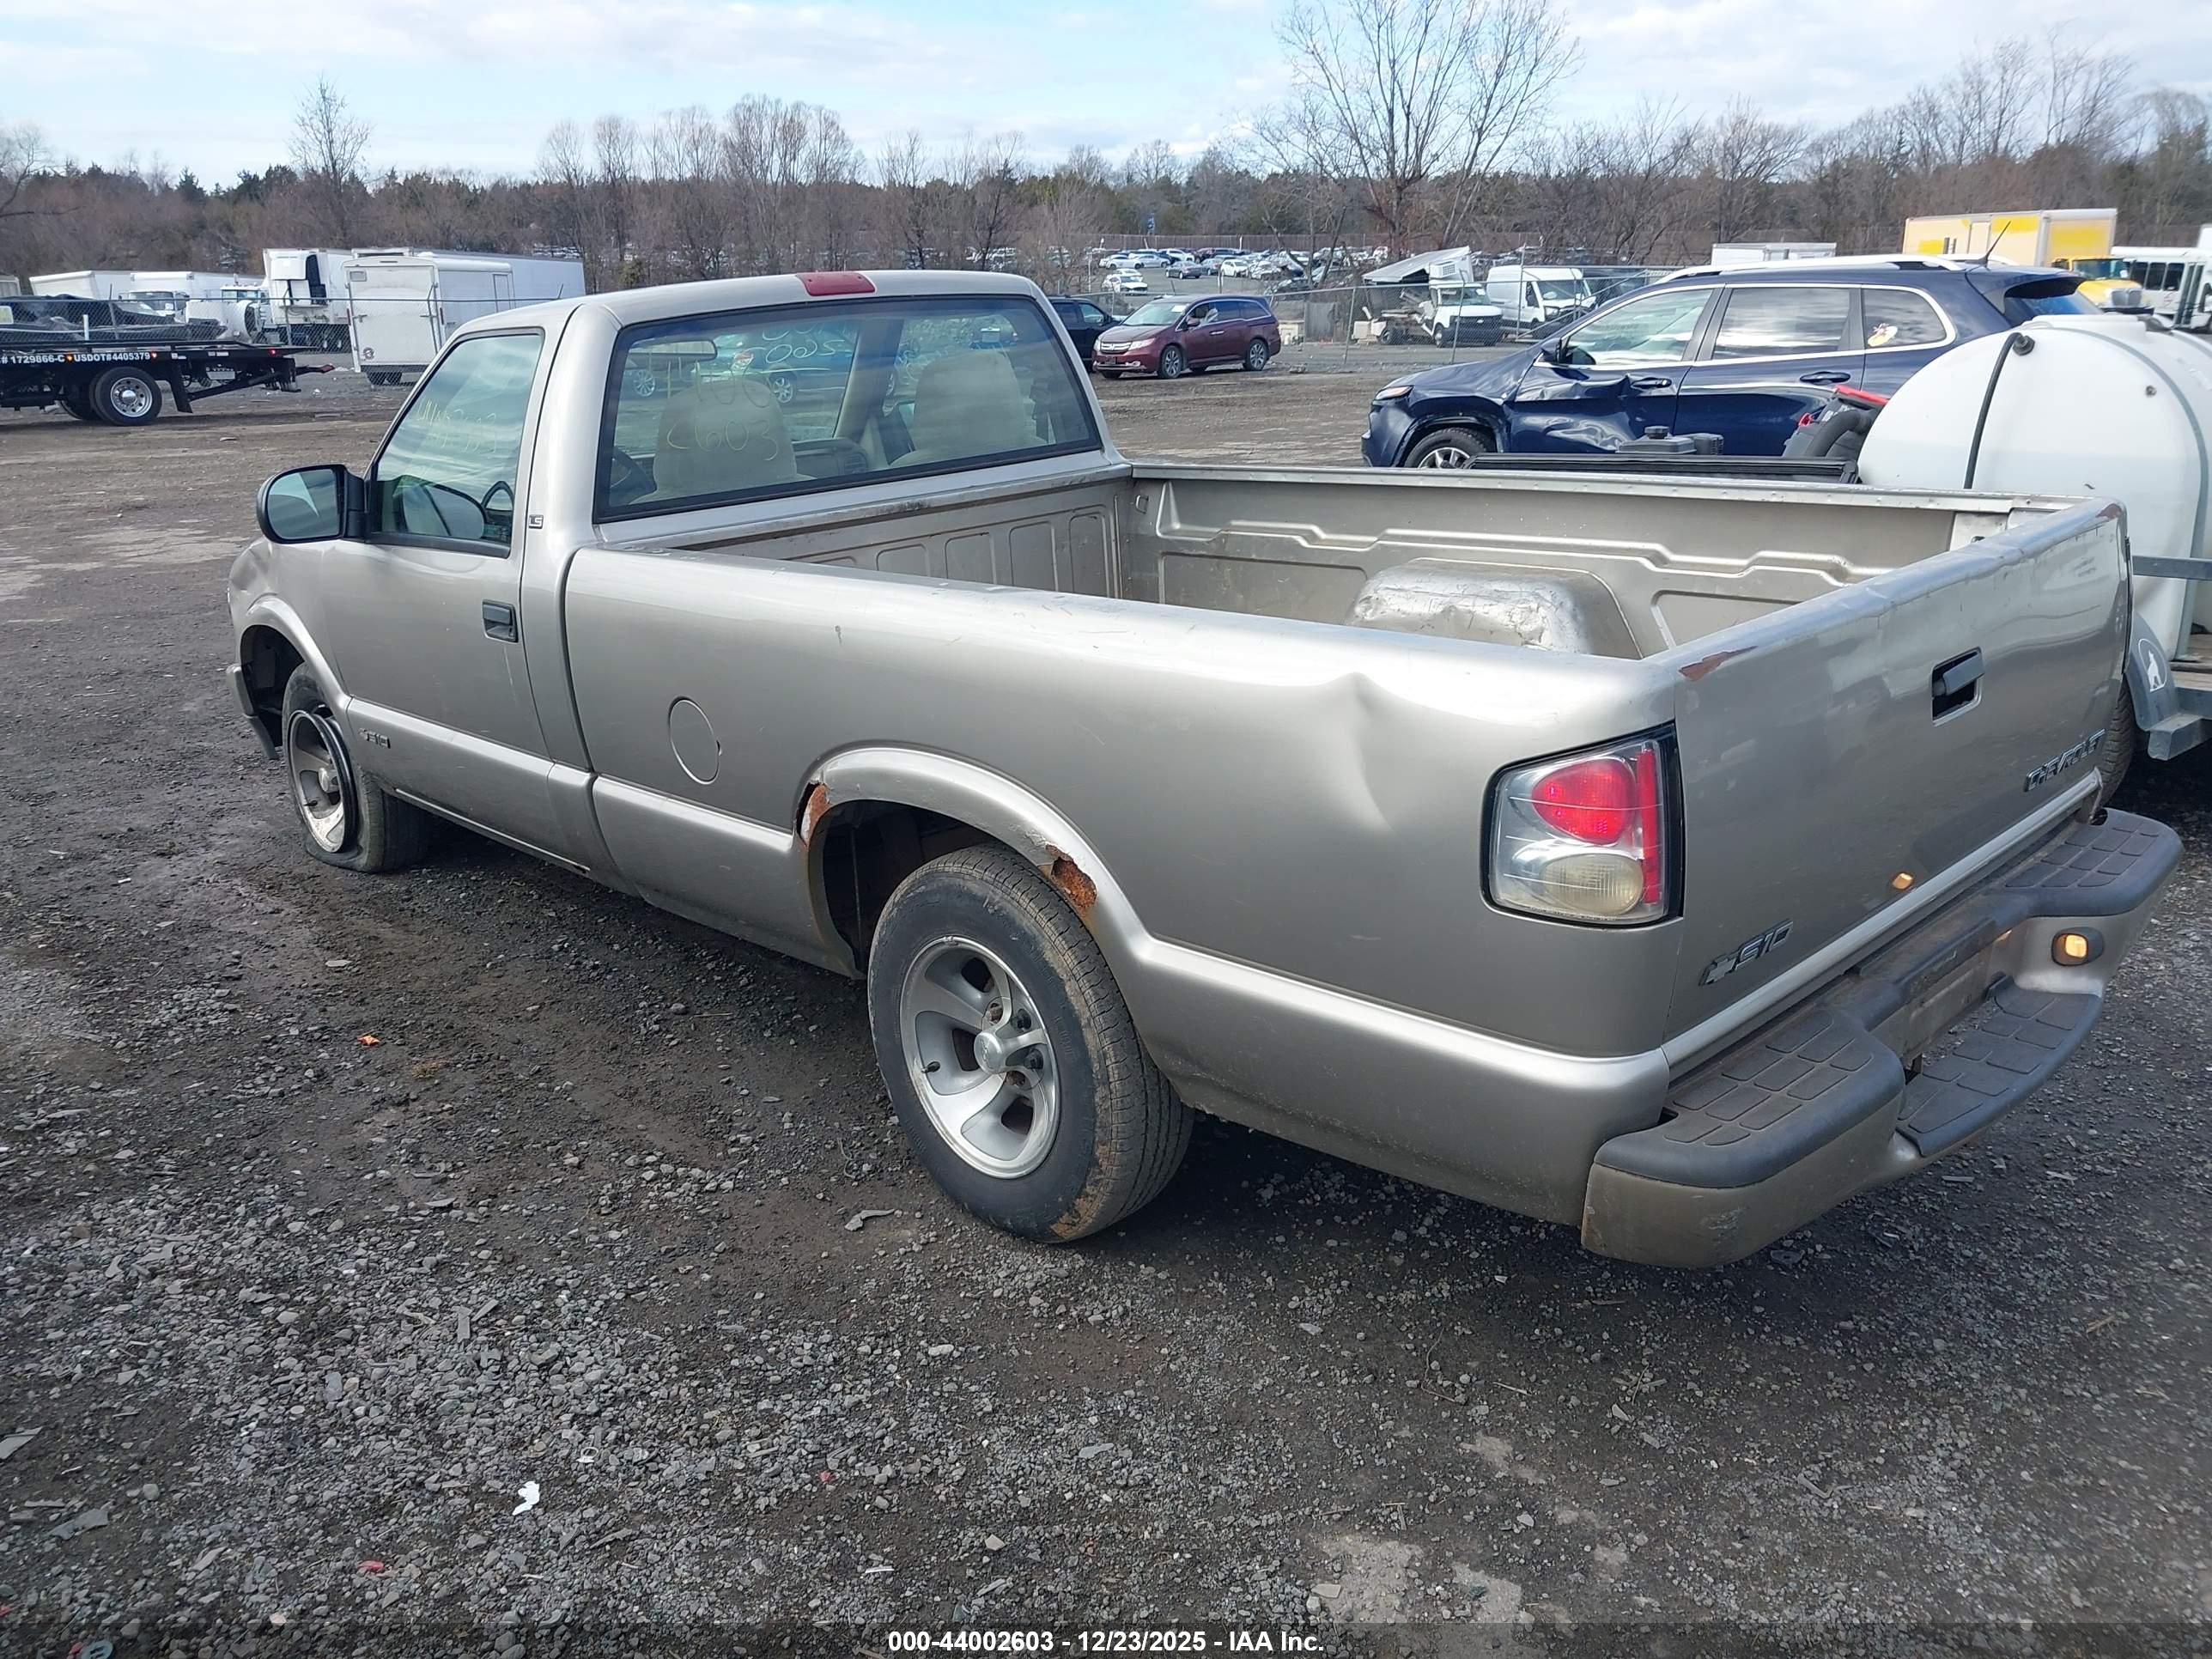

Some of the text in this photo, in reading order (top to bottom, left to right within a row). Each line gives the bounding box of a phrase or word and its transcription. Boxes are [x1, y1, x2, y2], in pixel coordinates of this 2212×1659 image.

[10, 354, 65, 364] 1729866-C
[74, 352, 150, 362] USDOT#4405379
[528, 514, 544, 530] LS
[2025, 728, 2106, 792] CHEVROLET
